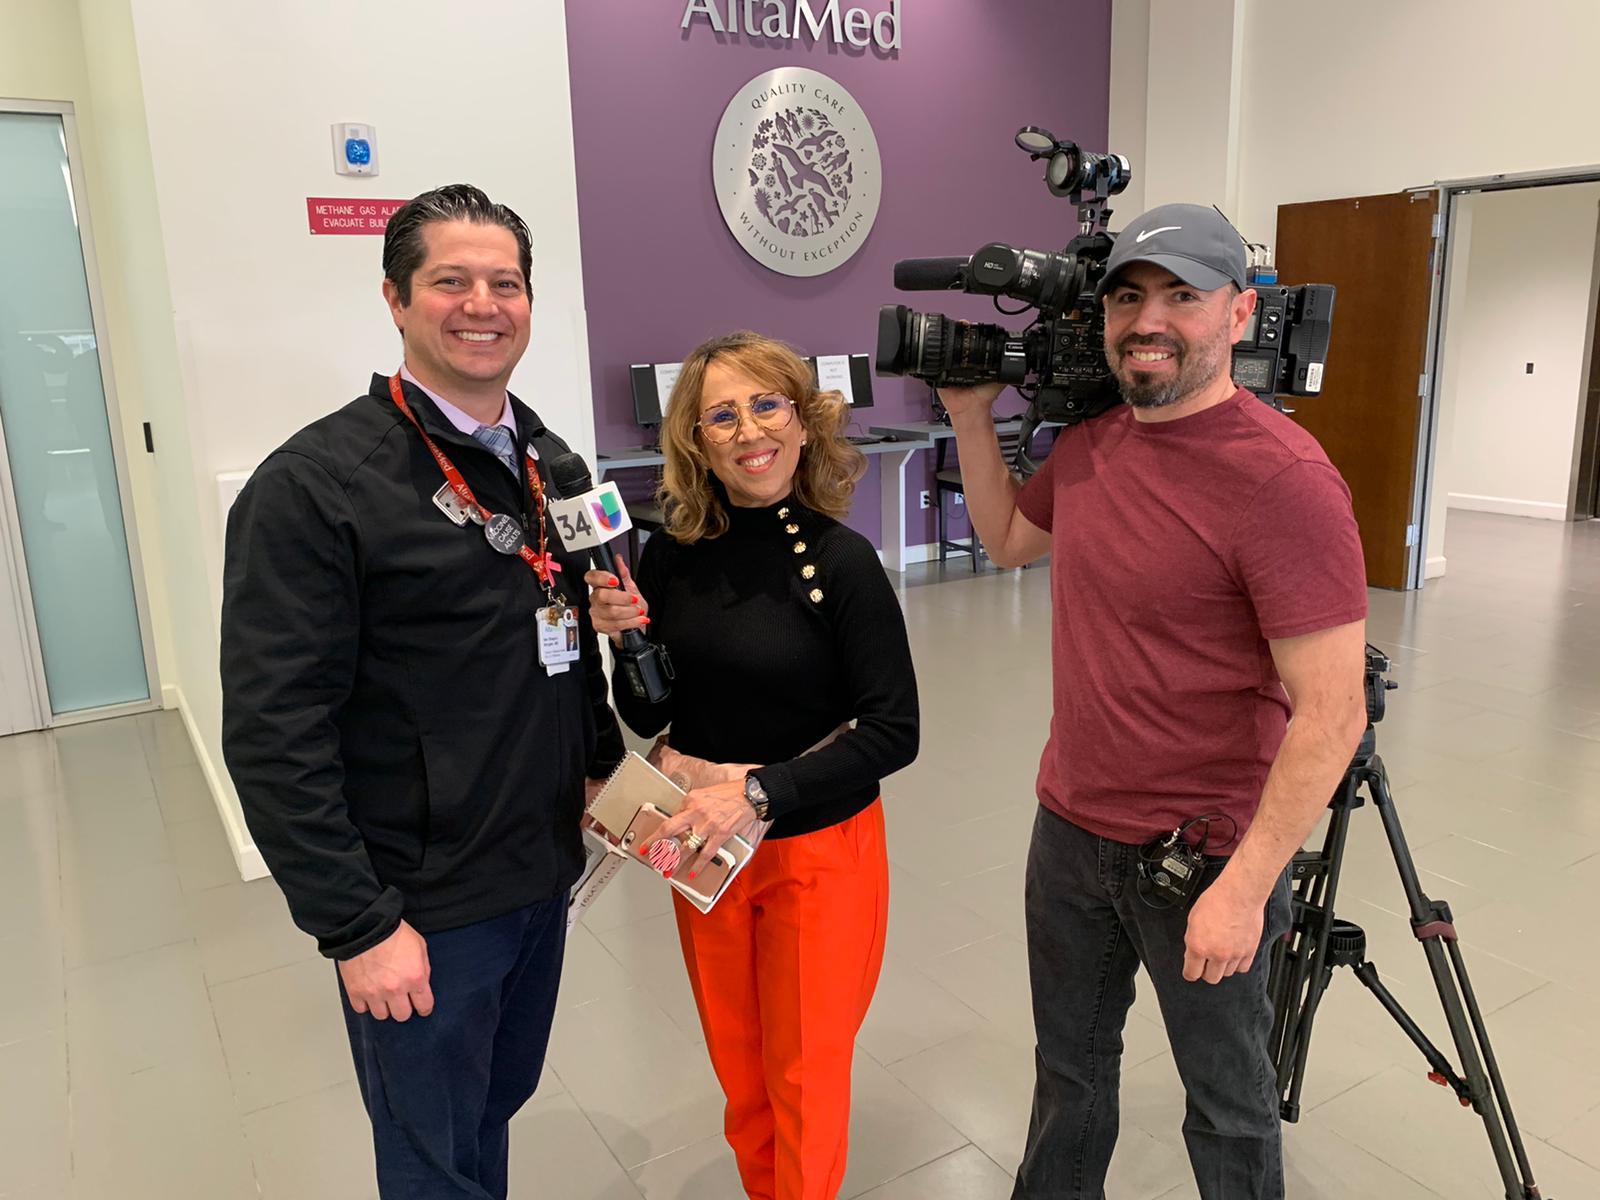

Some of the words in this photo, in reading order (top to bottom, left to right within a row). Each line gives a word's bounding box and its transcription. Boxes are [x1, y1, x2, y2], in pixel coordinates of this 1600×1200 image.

[681, 0, 901, 49] AltaMed
[751, 83, 807, 110] QUALITY
[814, 88, 846, 115] CARE
[315, 205, 355, 215] METHANE
[359, 205, 377, 216] GAS
[323, 218, 365, 228] EVACUATE
[739, 211, 796, 261] WITHOUT
[803, 211, 864, 262] EXCEPTION
[556, 510, 592, 541] 34
